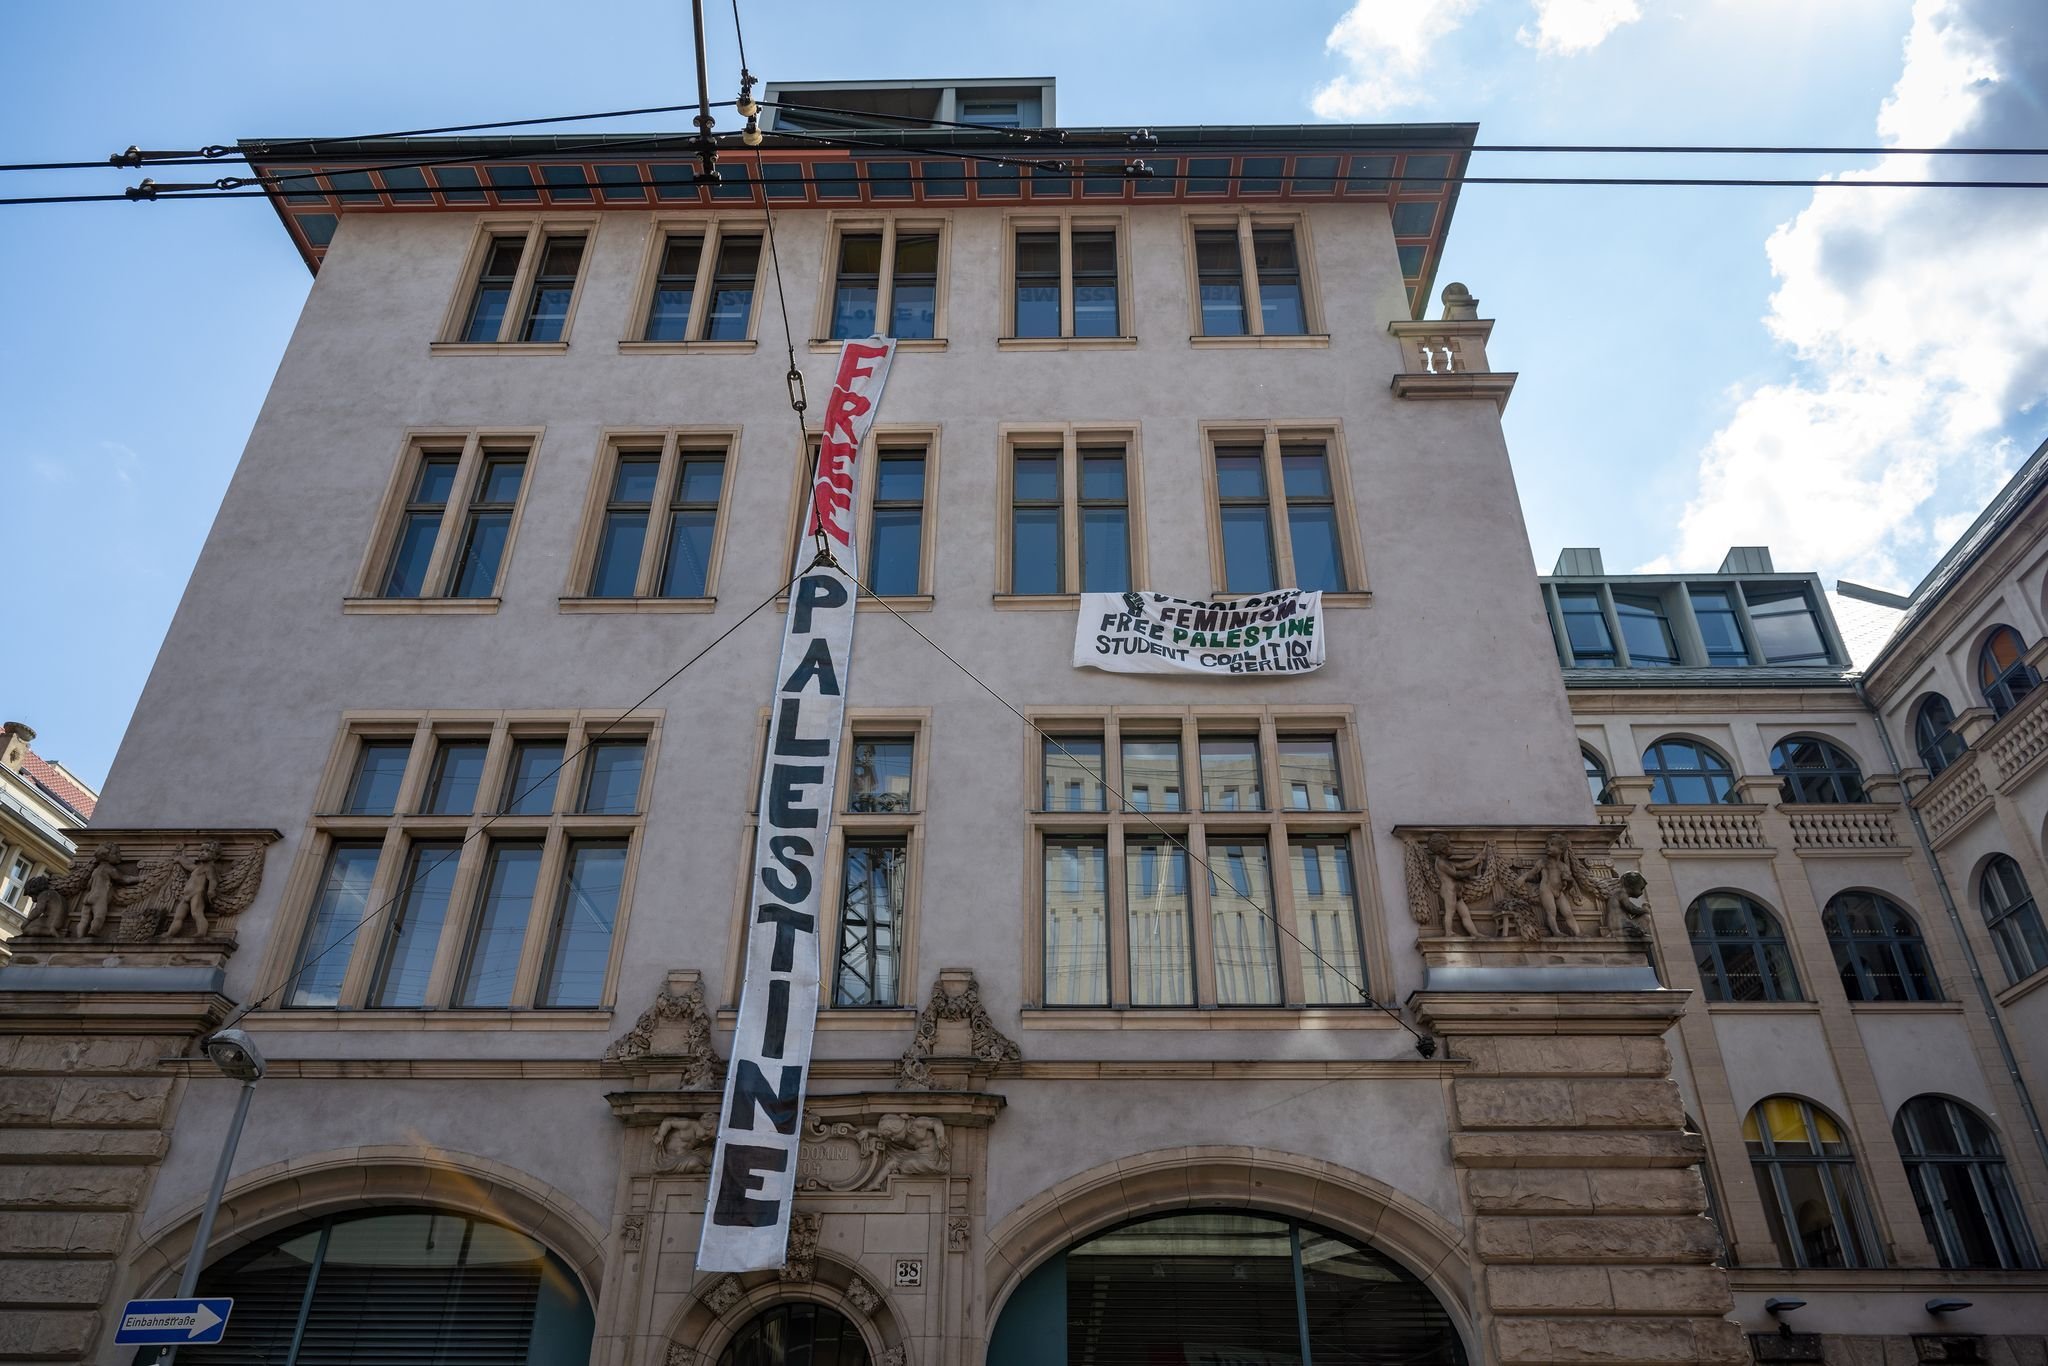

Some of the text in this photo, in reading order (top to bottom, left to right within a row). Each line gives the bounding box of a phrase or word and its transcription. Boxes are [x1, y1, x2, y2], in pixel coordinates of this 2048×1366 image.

[808, 343, 888, 547] FREE
[1100, 612, 1314, 648] FREE PALESTINE
[1096, 635, 1189, 662] STUDENT
[1230, 657, 1311, 673] BERLIN
[713, 575, 848, 1227] PALESTINE
[801, 1146, 848, 1160] DOMINI
[899, 1263, 918, 1277] 38
[126, 1316, 196, 1327] Einbahnstraße
